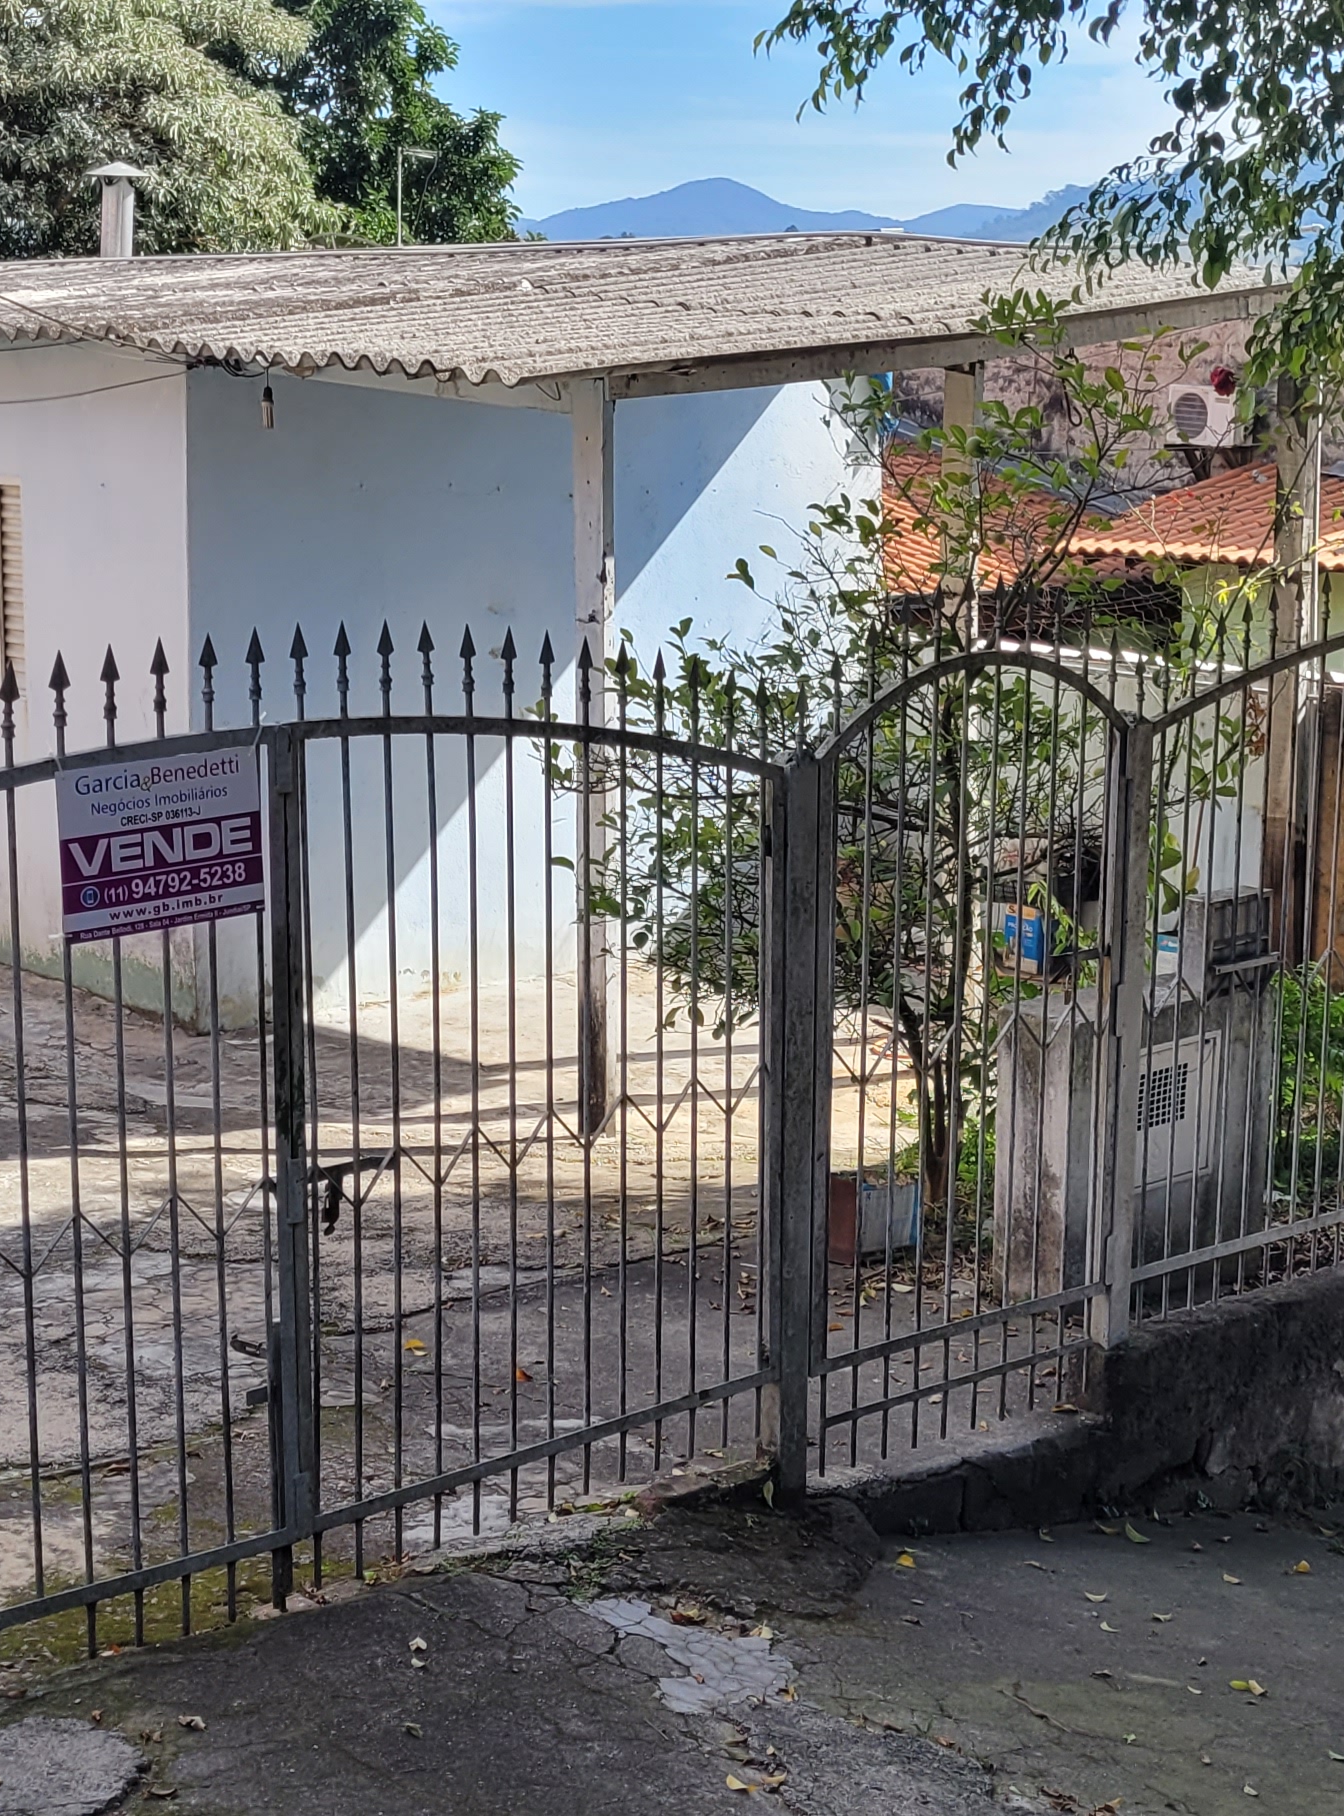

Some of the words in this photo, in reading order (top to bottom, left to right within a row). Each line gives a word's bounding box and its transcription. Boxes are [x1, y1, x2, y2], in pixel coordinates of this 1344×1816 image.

[90, 796, 151, 817] Negócios
[154, 785, 228, 807] Imobiliários
[120, 811, 164, 827] CRECI-SP
[165, 806, 202, 821] 036113-J
[67, 816, 253, 877] VENDE
[103, 884, 129, 904] (11)
[131, 861, 247, 900] 94792-5238
[109, 893, 224, 921] www.gb.imb.br
[80, 931, 93, 940] Rua
